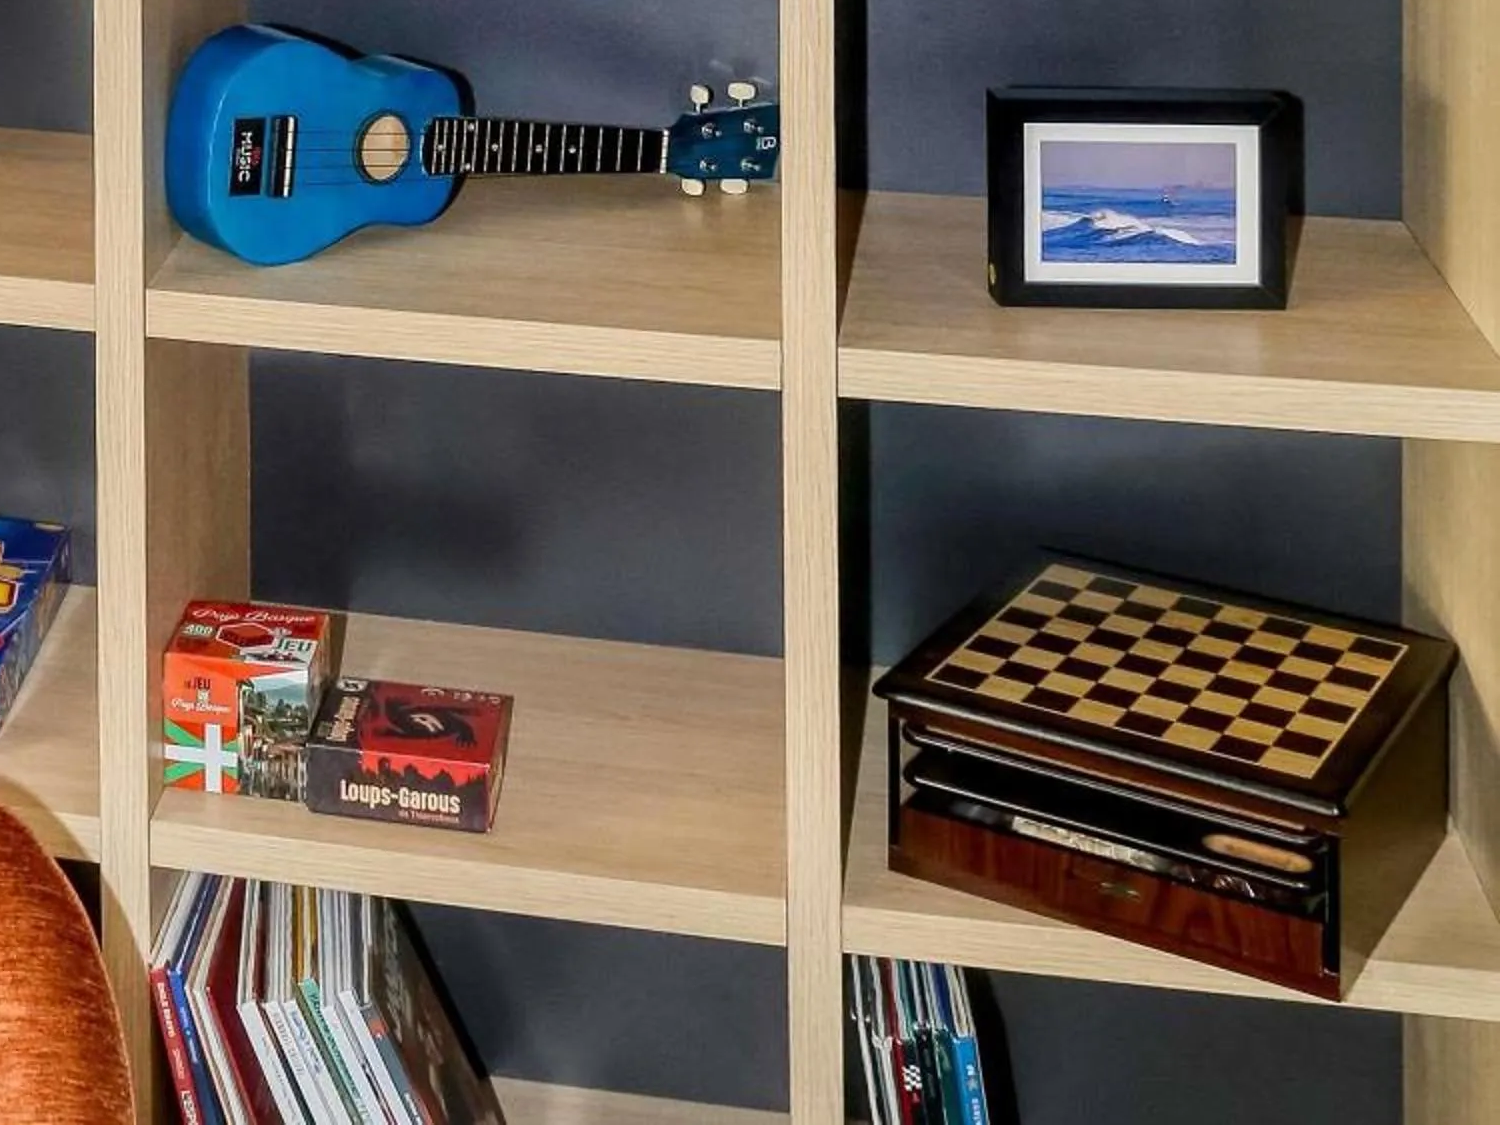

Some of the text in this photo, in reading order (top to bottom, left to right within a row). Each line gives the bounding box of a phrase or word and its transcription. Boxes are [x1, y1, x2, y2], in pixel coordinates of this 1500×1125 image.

[238, 131, 253, 183] MUSIC
[276, 638, 312, 653] JEU
[339, 778, 462, 814] Loups-Garous
